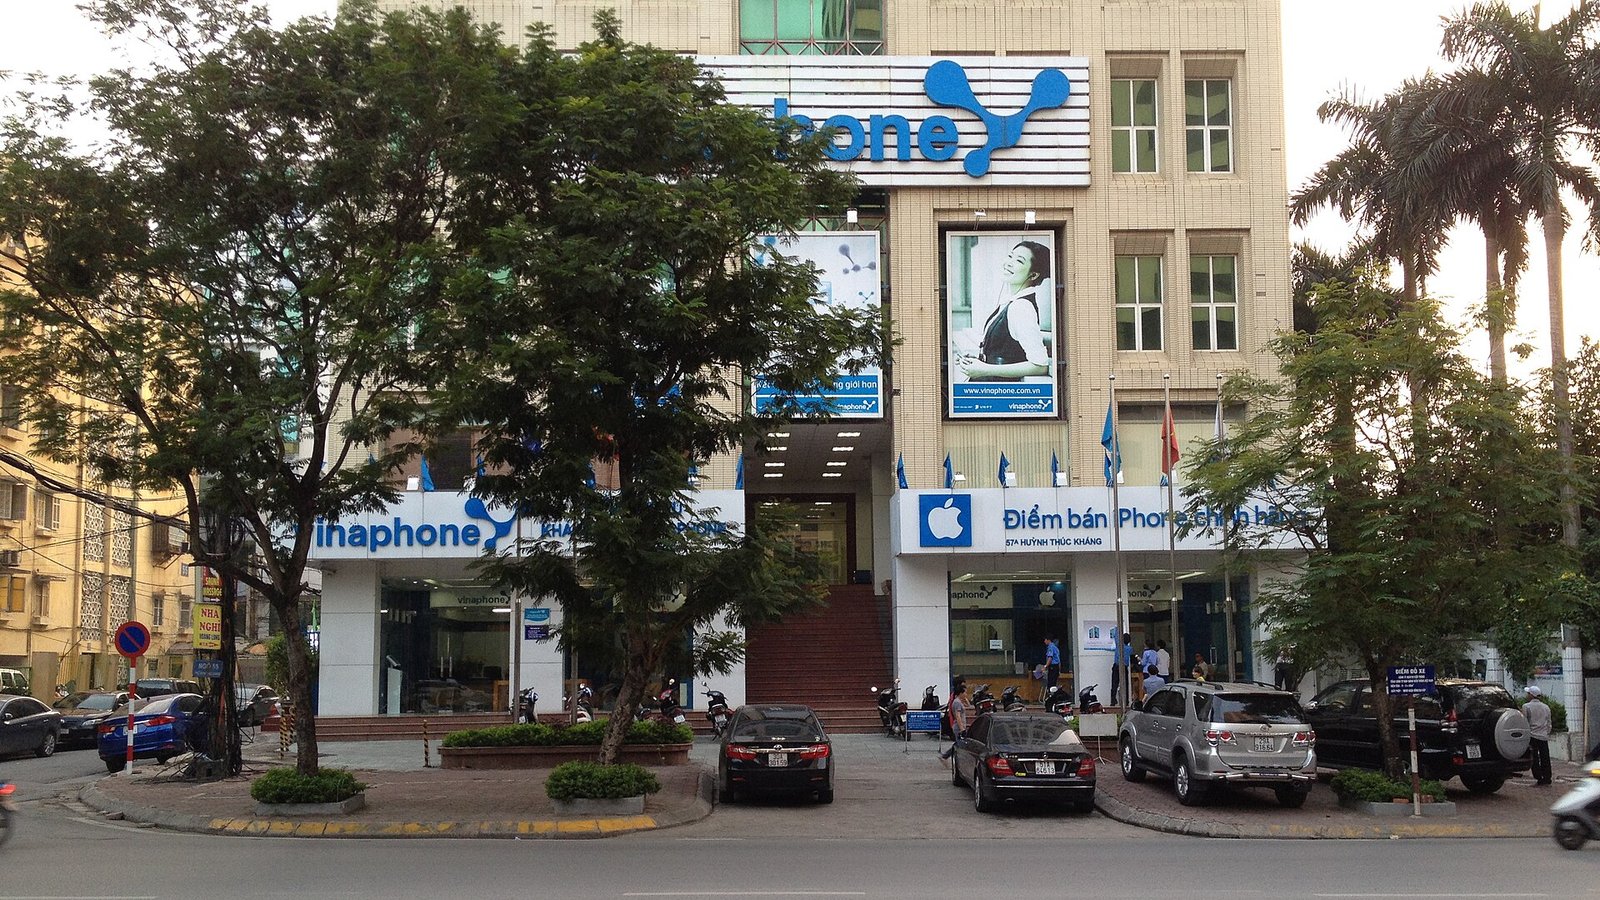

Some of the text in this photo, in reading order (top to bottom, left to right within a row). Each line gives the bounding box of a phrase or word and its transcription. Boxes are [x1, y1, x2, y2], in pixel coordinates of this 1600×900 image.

[963, 387, 1041, 395] www.vinaphone.com.vn
[1009, 402, 1042, 411] vinaphone
[1003, 504, 1062, 529] Điểm
[1068, 507, 1107, 529] bán
[1114, 506, 1188, 528] Phone
[293, 516, 481, 552] inaphone
[1020, 537, 1048, 546] HUỲNH
[1050, 537, 1071, 546] THÚC
[1074, 537, 1102, 545] KHÁNG
[457, 596, 506, 605] vinaphone
